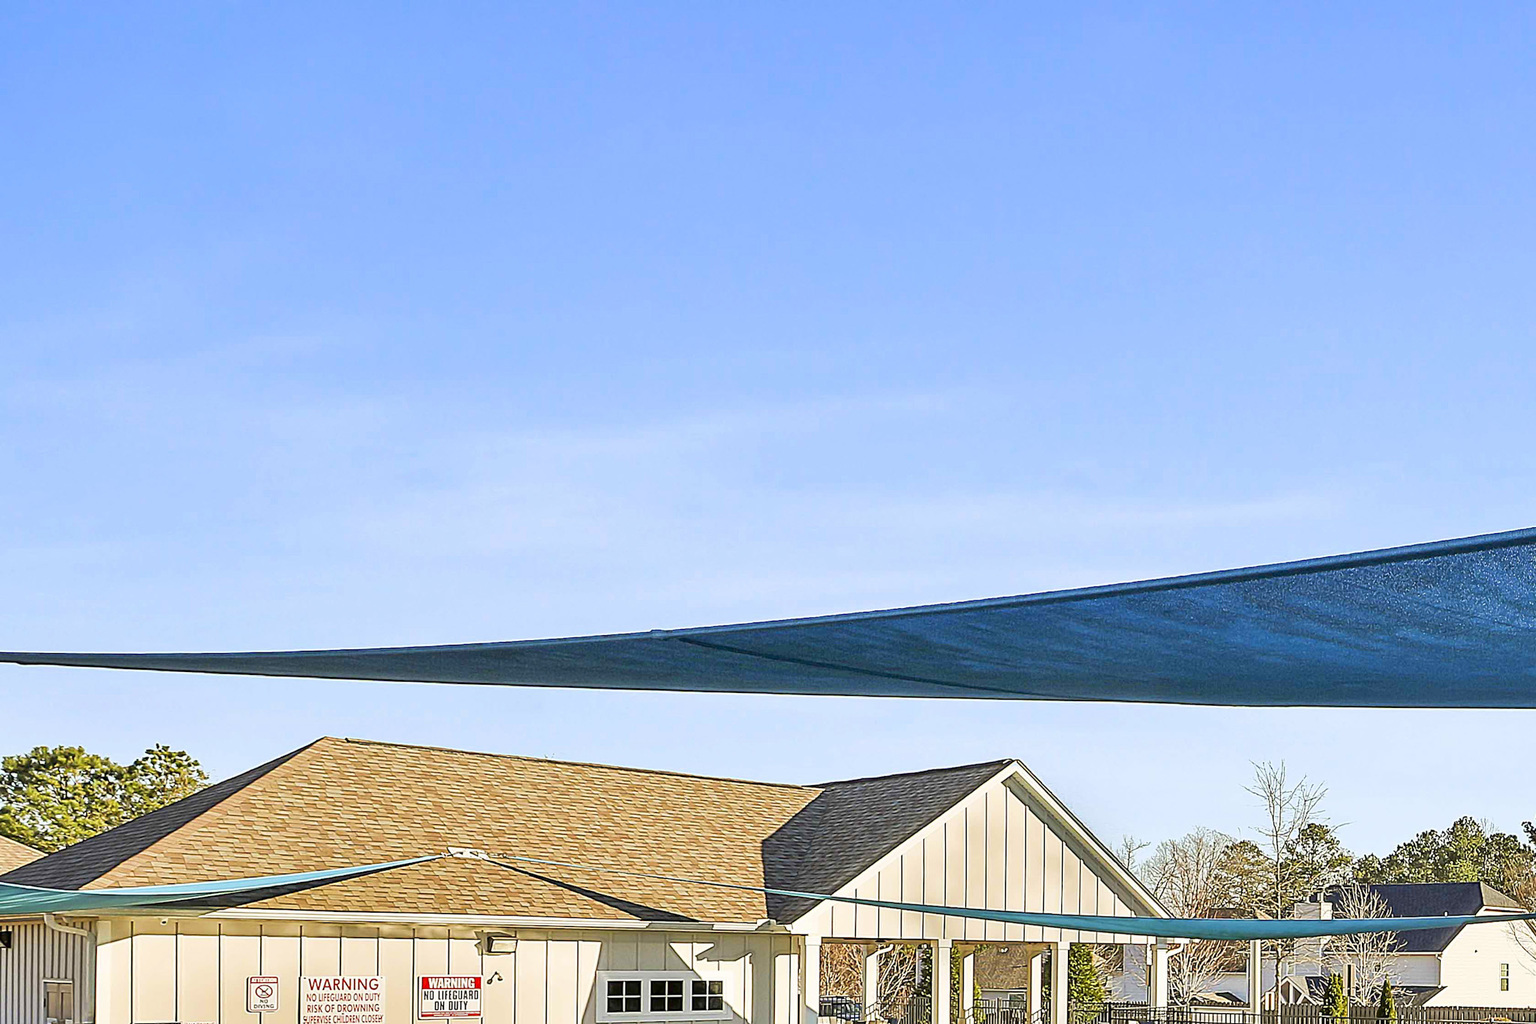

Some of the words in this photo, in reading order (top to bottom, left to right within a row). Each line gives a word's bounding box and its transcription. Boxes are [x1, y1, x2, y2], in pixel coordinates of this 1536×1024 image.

[308, 978, 379, 991] WARNING
[428, 977, 475, 989] WARNING
[306, 993, 317, 1002] NO
[318, 993, 352, 1002] LIFEGUARD
[353, 993, 363, 1002] ON
[365, 993, 380, 1001] DUTY
[424, 990, 434, 1000] NO
[438, 990, 479, 1000] LIFEGUARD
[307, 1004, 323, 1013] RISK
[324, 1004, 335, 1013] OF
[337, 1003, 380, 1013] DROWNING
[435, 1001, 445, 1011] ON
[448, 1001, 468, 1010] DUTY
[303, 1015, 331, 1024] SUPERVISE
[333, 1015, 360, 1024] CHILDREN
